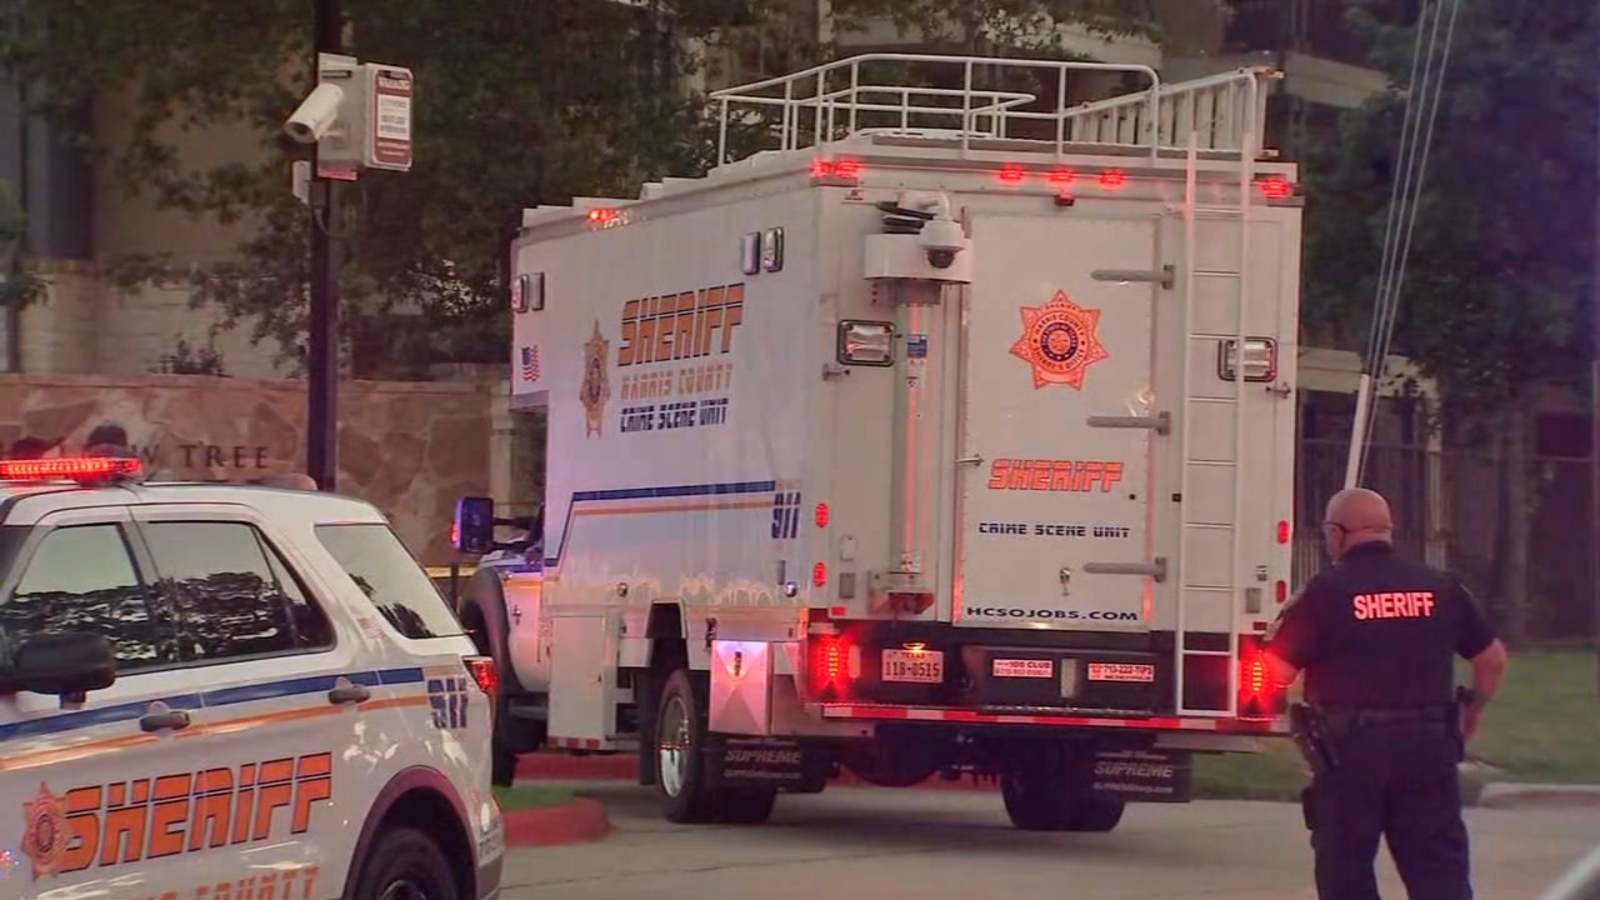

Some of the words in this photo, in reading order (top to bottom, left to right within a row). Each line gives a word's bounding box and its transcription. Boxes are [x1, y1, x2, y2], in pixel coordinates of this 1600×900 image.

[618, 283, 745, 366] SHERIFF
[620, 372, 674, 401] HARRIS
[678, 364, 734, 395] COUNTY
[620, 405, 656, 433] CRIME
[658, 401, 697, 430] SCENE
[699, 398, 729, 425] UNIT
[178, 445, 269, 469] TREE
[988, 459, 1123, 492] SHERIFF
[772, 492, 801, 538] 911
[979, 522, 1027, 536] CRIME
[1034, 523, 1086, 537] SCENE
[1093, 525, 1130, 538] UNIT
[966, 606, 1138, 621] HCSOJOBS.COM
[1353, 592, 1434, 620] SHERIFF
[428, 677, 468, 729] 911
[724, 750, 802, 768] SUPREME
[1094, 761, 1174, 778] SUPREME
[60, 750, 333, 873] SHERIFF
